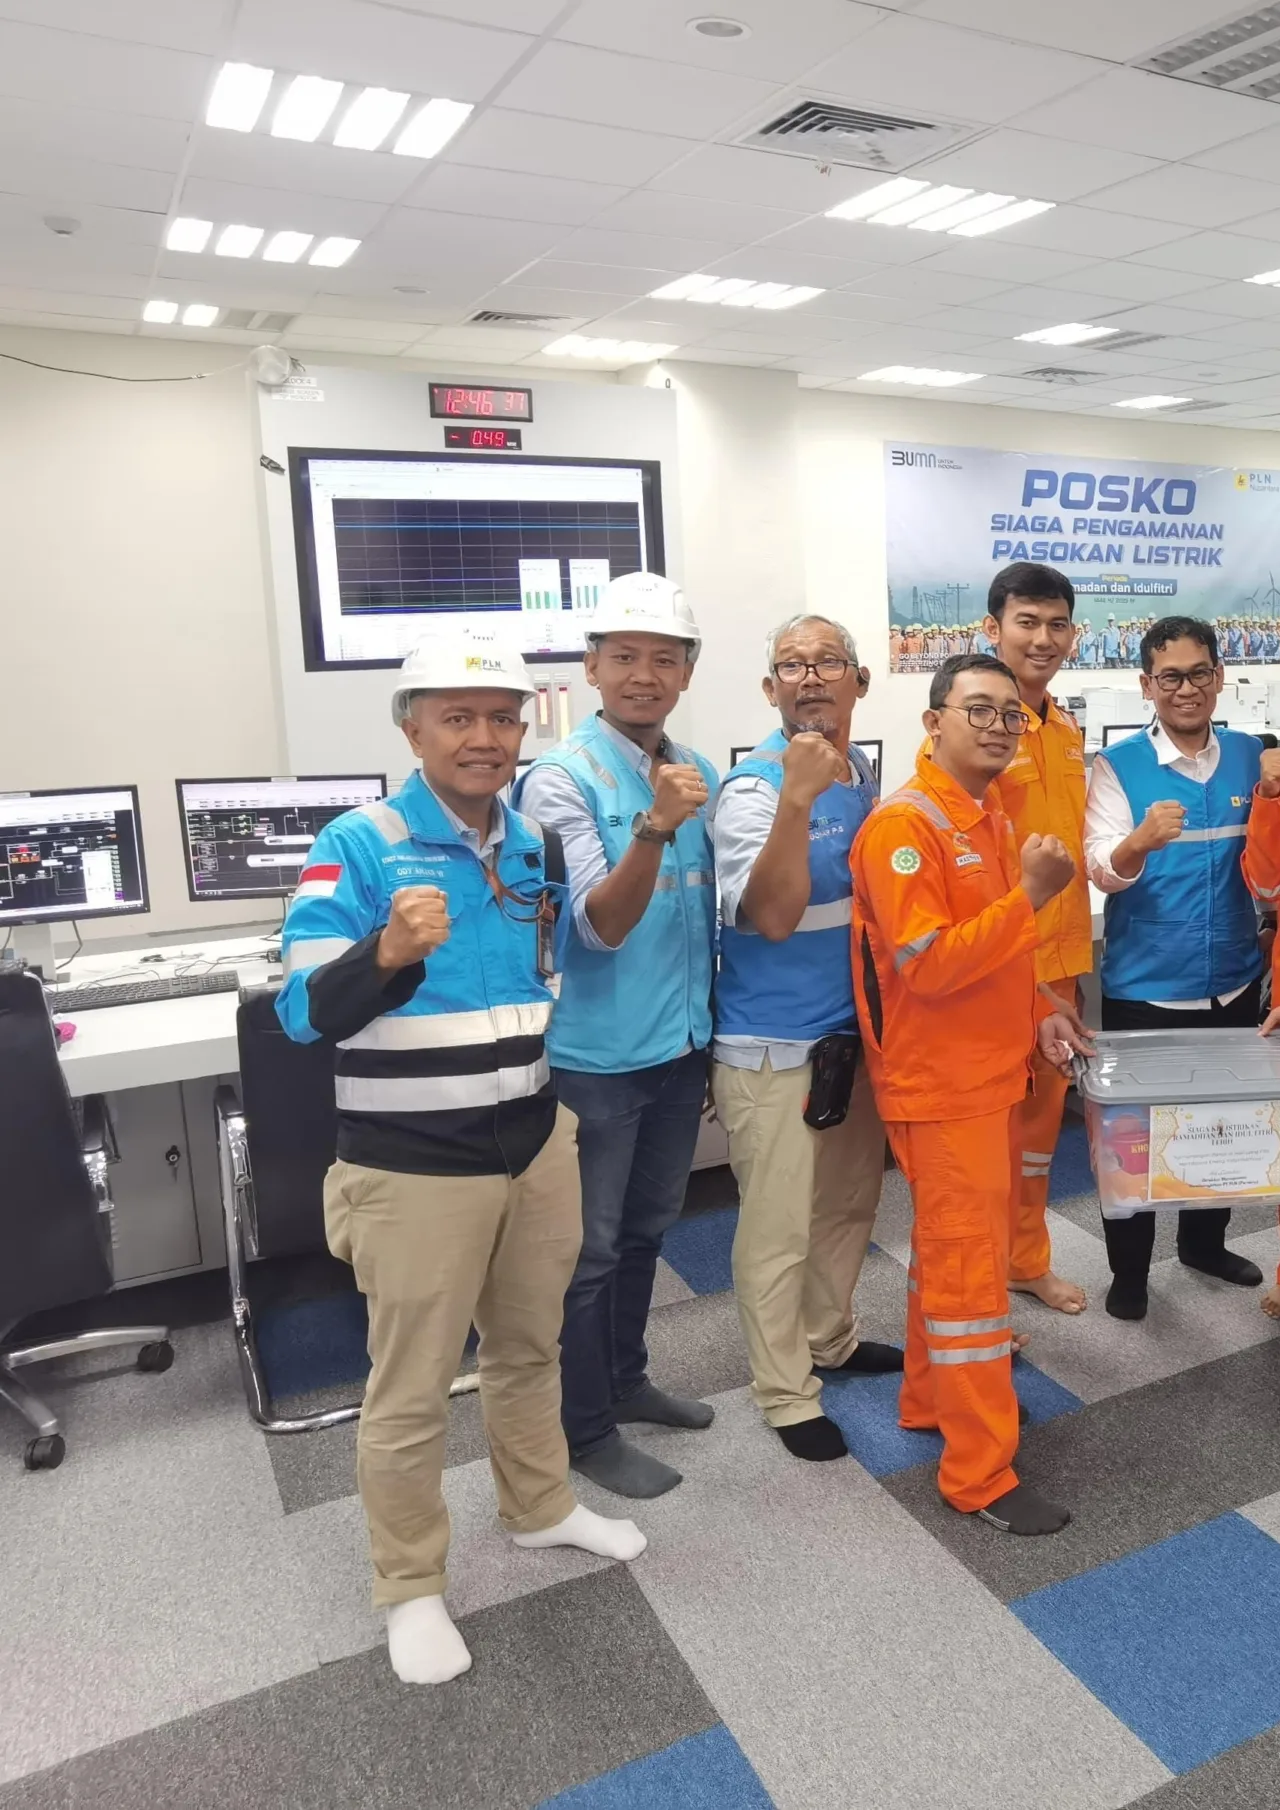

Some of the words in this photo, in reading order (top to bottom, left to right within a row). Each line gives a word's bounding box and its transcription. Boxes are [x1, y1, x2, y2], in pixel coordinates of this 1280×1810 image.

[1249, 473, 1272, 484] PLN
[1021, 469, 1197, 516] POSKO
[990, 513, 1064, 535] SIAGA
[1072, 516, 1225, 541] PENGAMANAN
[992, 539, 1126, 564] PASOKAN
[1132, 543, 1224, 567] LISTRIK
[1072, 581, 1108, 593] madan
[1110, 581, 1131, 593] dan
[1133, 582, 1174, 595] Idulfitri
[482, 659, 502, 669] PLN
